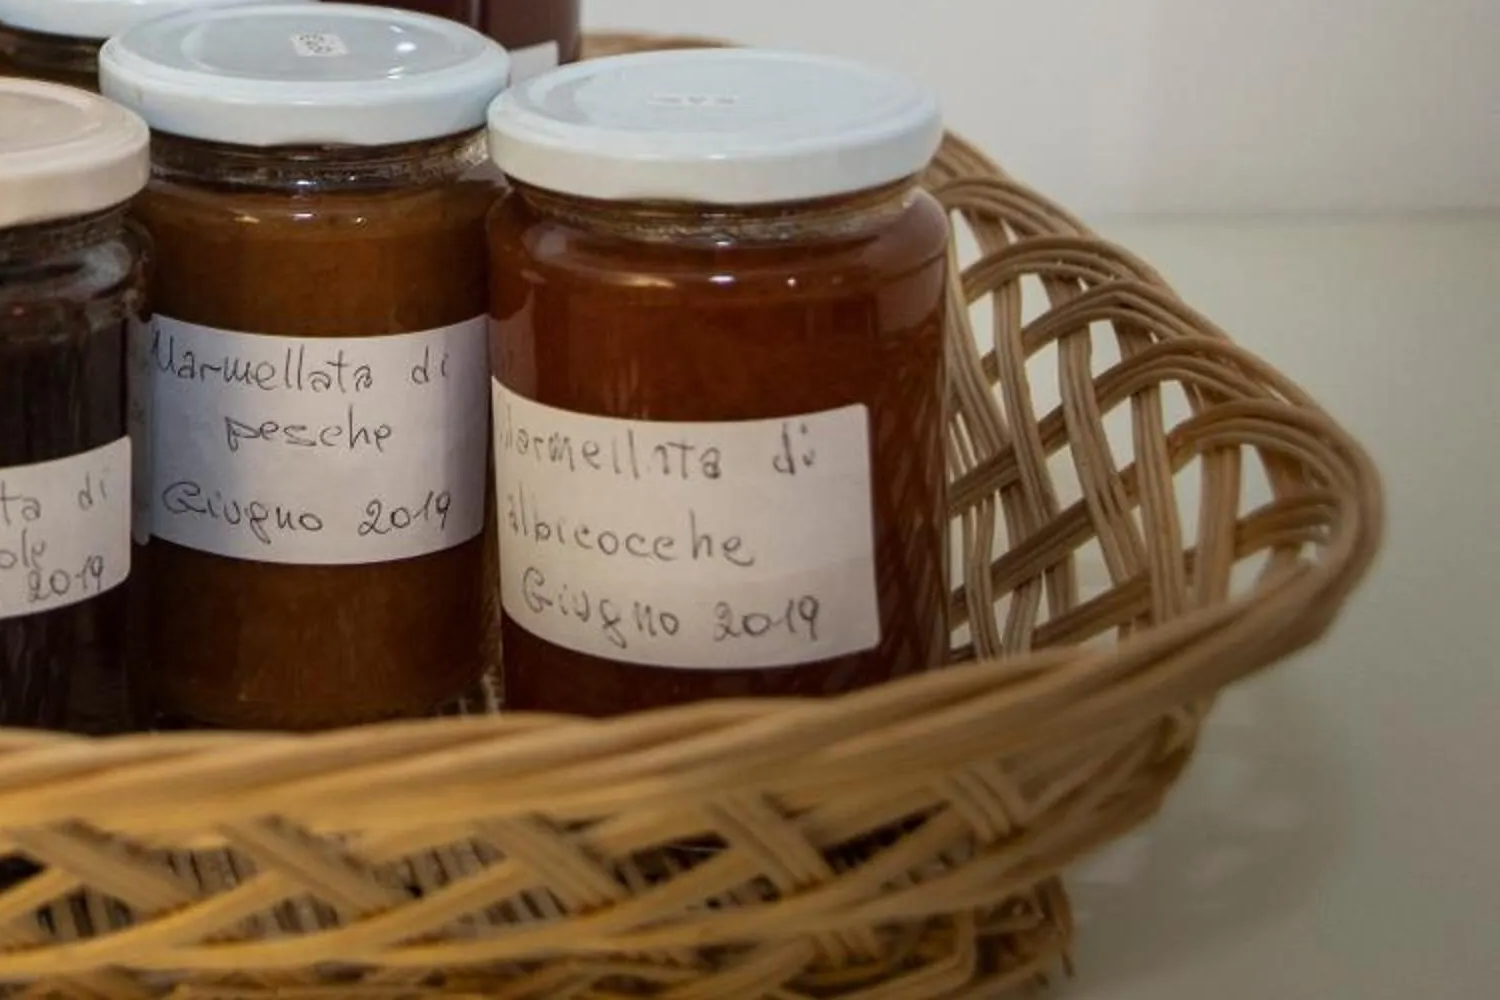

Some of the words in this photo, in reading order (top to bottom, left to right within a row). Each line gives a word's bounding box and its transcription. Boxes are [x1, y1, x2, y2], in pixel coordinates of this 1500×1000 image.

[410, 346, 450, 386] di
[224, 404, 393, 453] pesche
[771, 422, 817, 476] di
[77, 471, 109, 511] di
[162, 481, 324, 546] Giugno
[357, 490, 453, 538] 2019
[27, 555, 106, 602] 2019
[520, 566, 681, 650] Giugno
[711, 594, 821, 642] 2019
